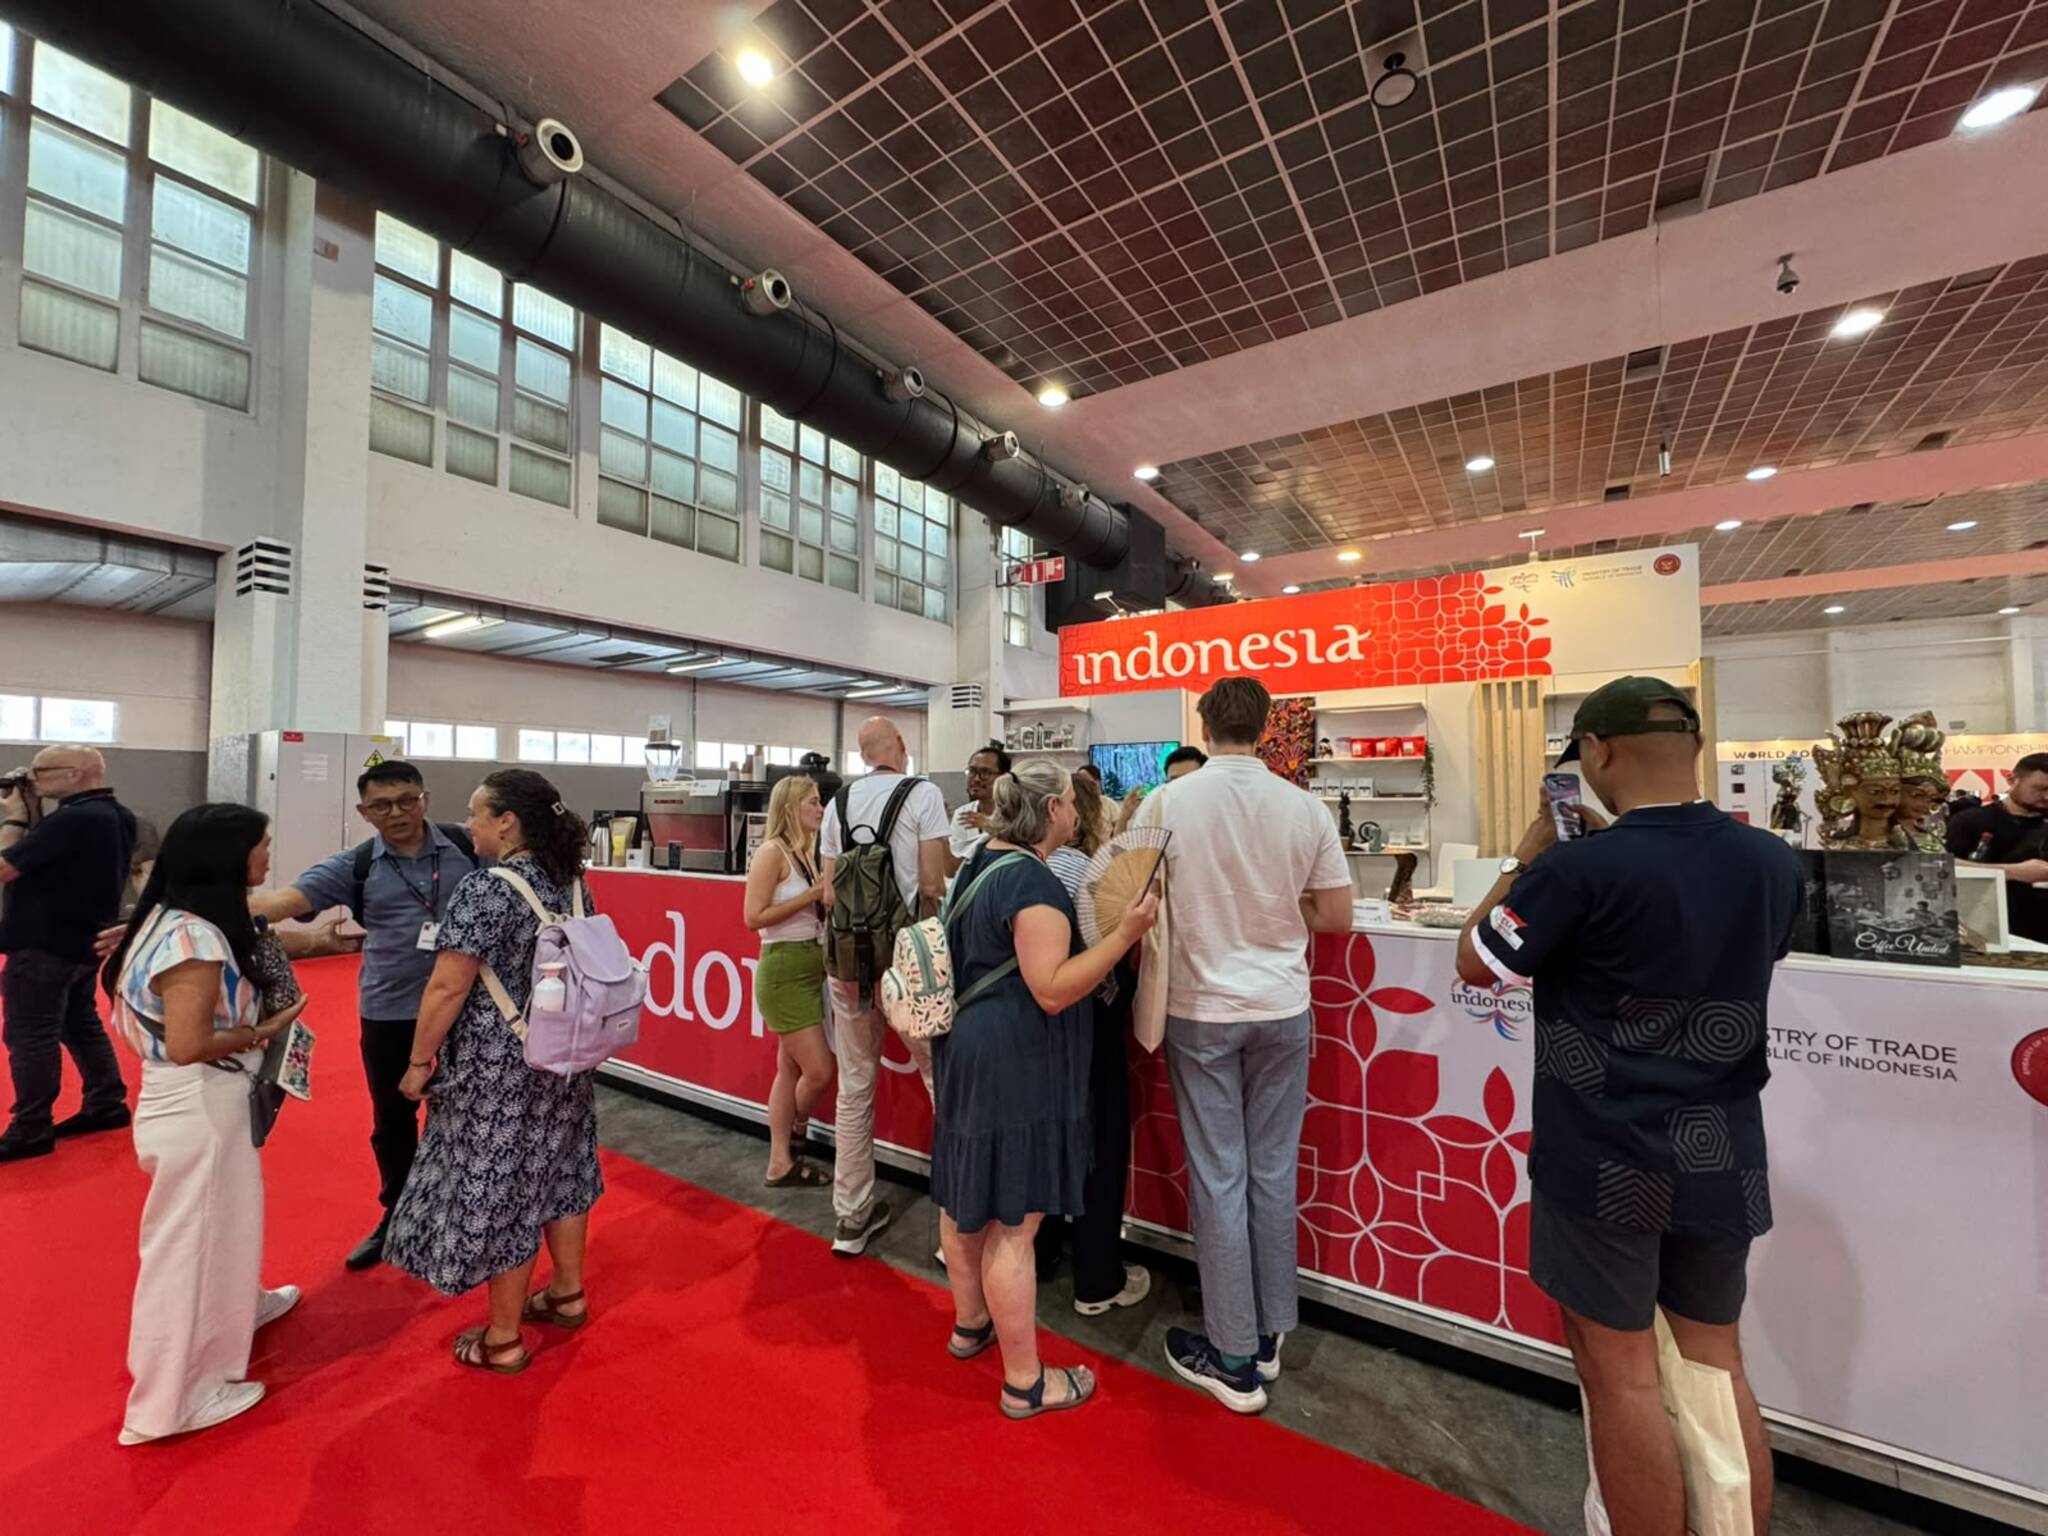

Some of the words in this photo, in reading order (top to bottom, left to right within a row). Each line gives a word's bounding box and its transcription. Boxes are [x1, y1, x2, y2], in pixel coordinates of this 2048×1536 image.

[1073, 624, 1372, 685] indonesia
[1733, 750, 1785, 759] WORLD
[1450, 991, 1533, 1012] indonesi
[1825, 1034, 1860, 1051] OF
[1866, 1038, 1958, 1064] TRADE
[1806, 1051, 1834, 1066] OF
[1839, 1055, 1959, 1082] INDONESIA
